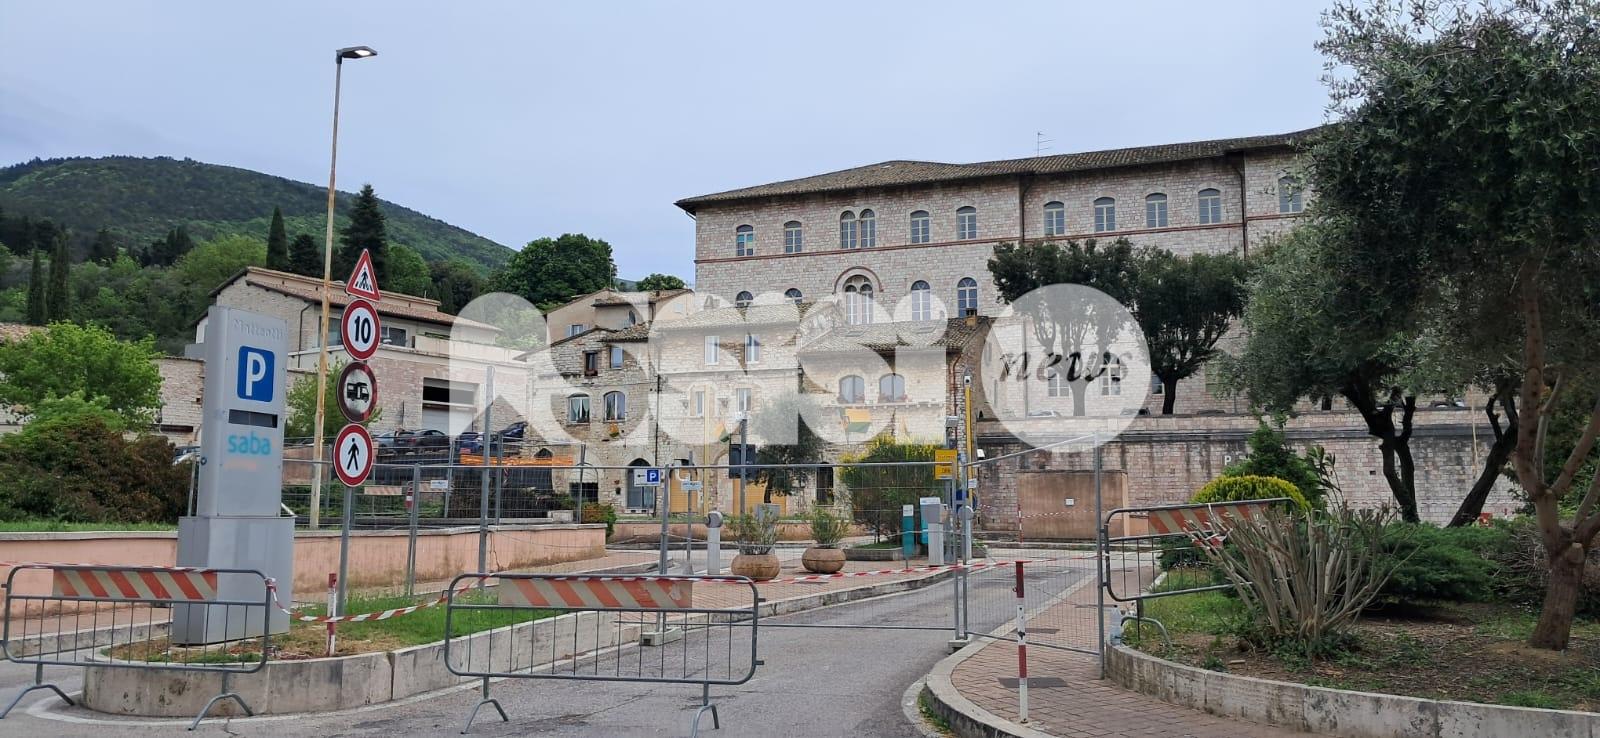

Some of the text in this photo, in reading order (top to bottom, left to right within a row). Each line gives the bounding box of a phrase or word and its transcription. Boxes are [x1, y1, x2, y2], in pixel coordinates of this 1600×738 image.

[354, 315, 371, 344] 10
[245, 351, 266, 397] P
[227, 430, 272, 456] saba
[649, 472, 657, 481] P
